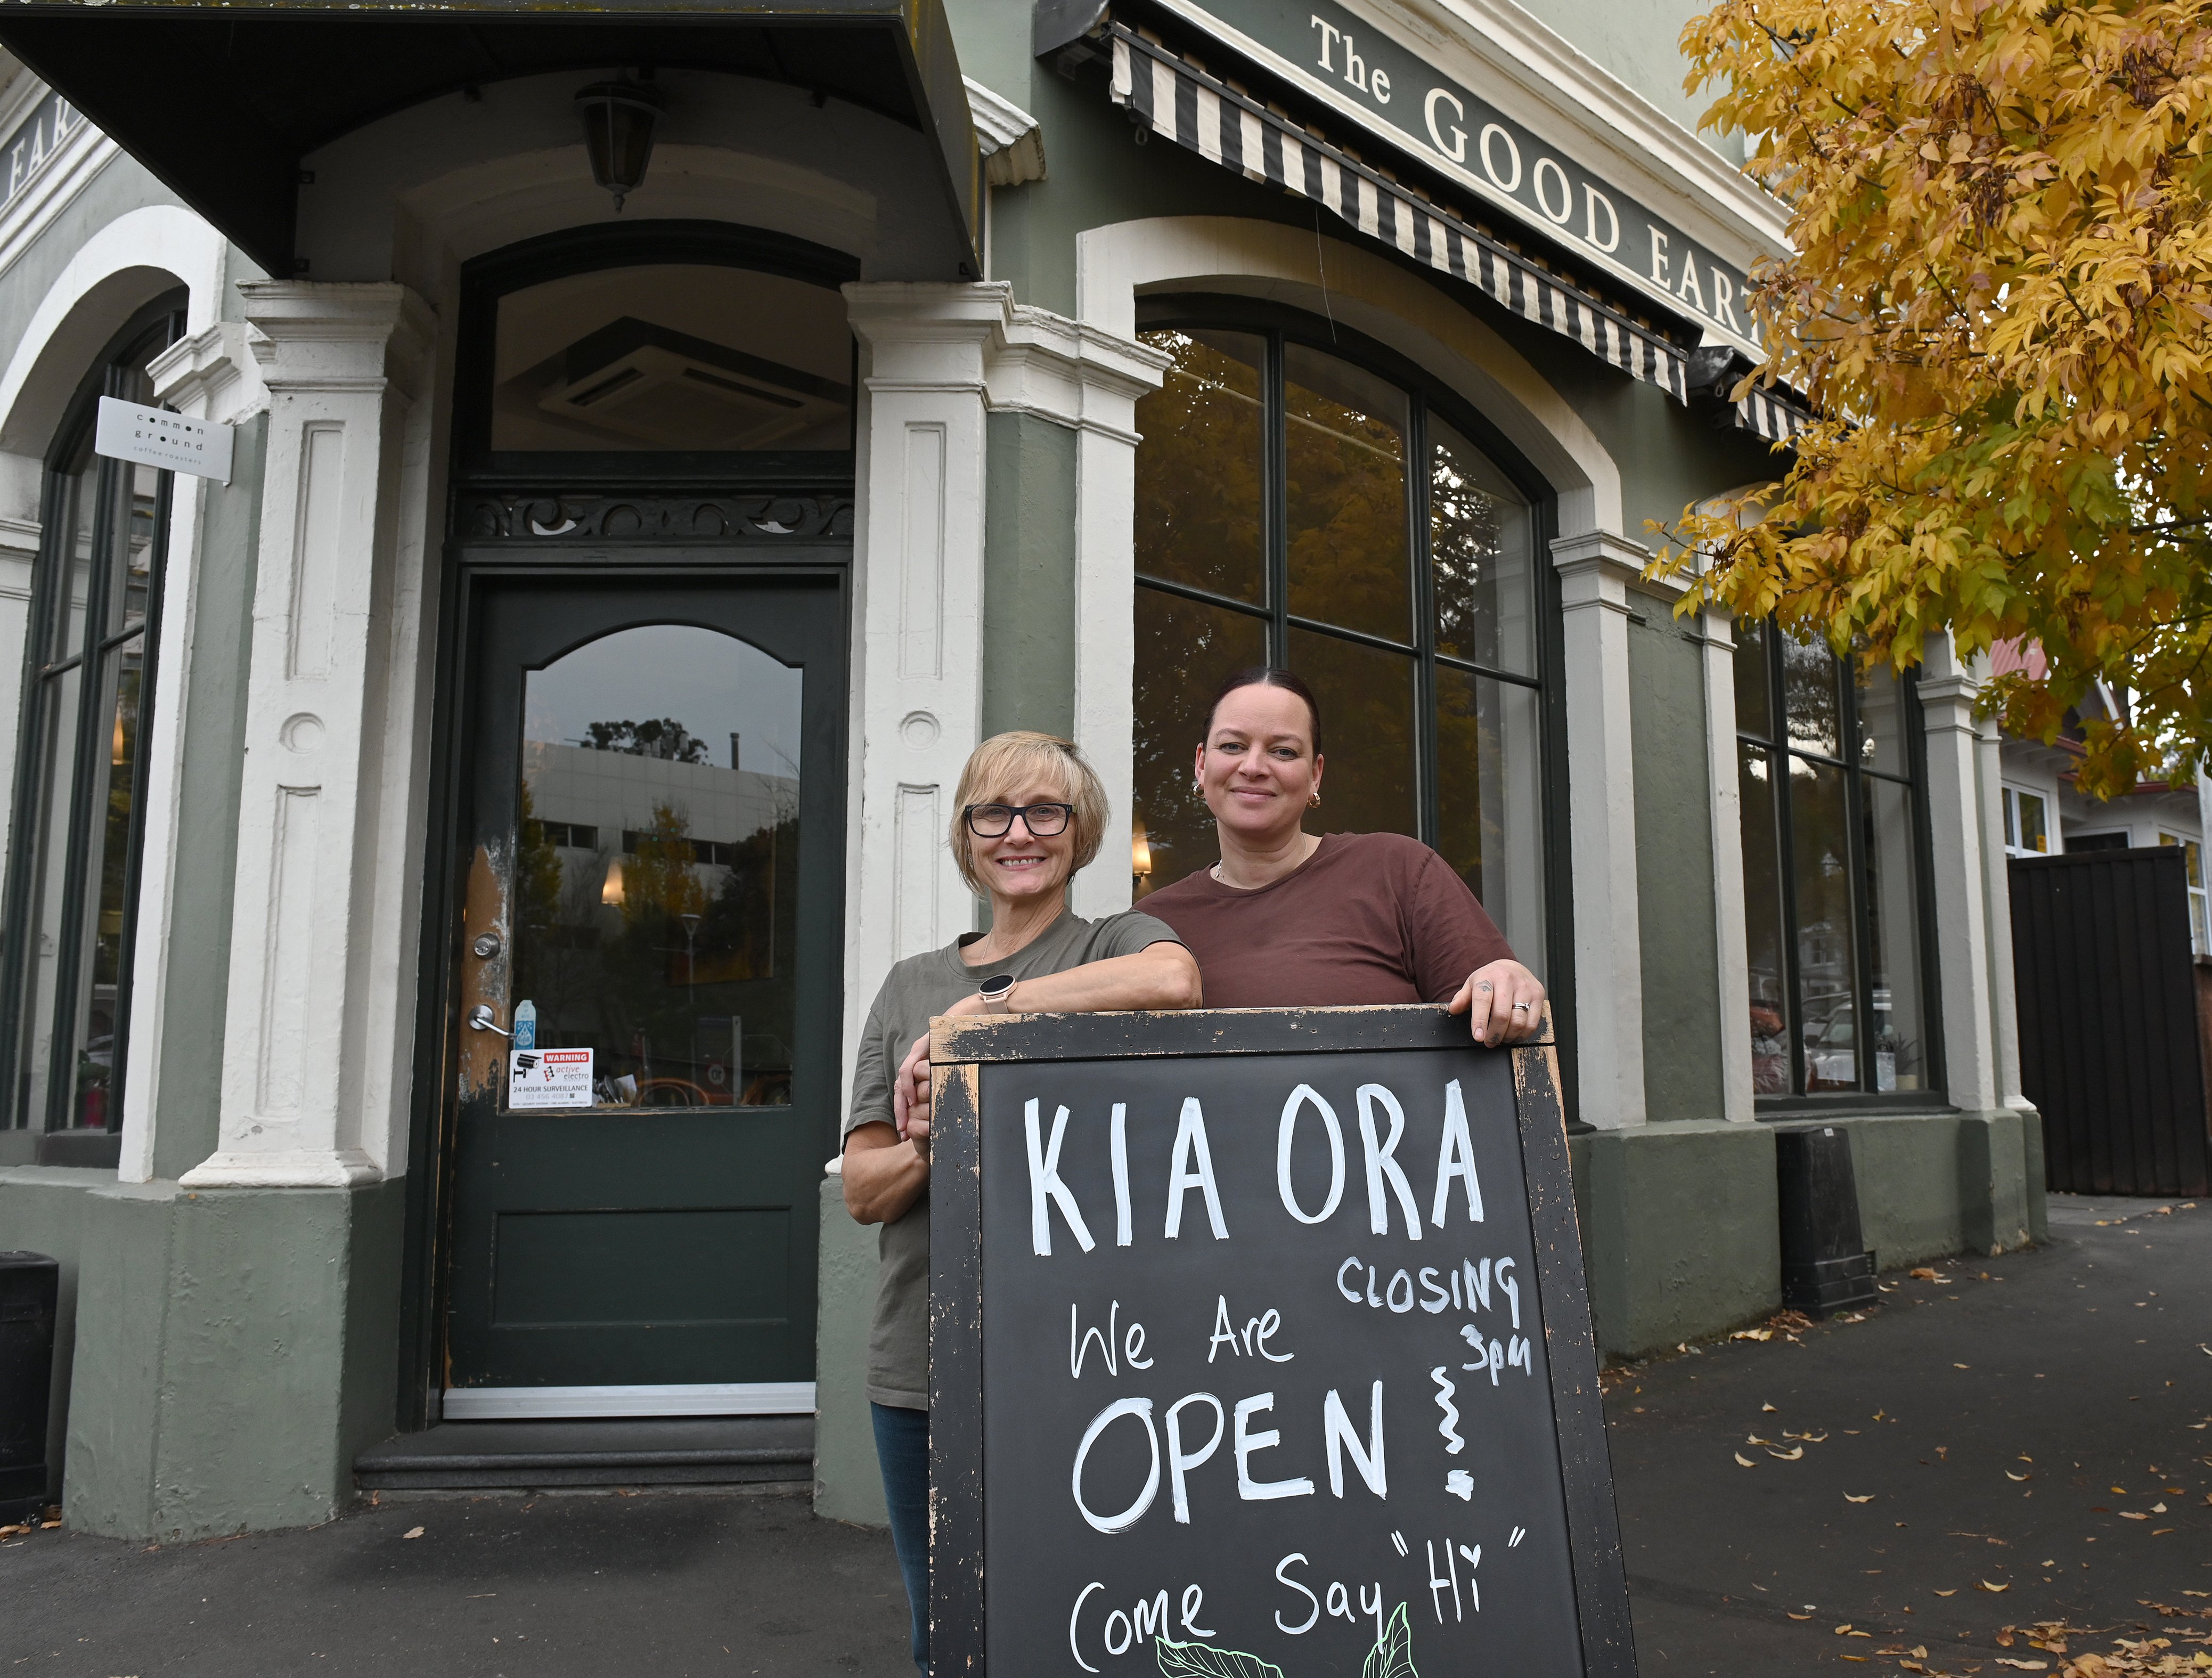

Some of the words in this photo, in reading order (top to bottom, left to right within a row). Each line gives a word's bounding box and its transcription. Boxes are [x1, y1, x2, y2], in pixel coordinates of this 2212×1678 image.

[1311, 14, 1391, 104] The
[1424, 87, 1620, 254] GOOD
[134, 429, 203, 451] ground
[136, 413, 204, 435] common
[133, 446, 162, 456] coffee
[165, 453, 202, 465] roasters
[546, 1053, 587, 1062] WARNING
[556, 1064, 580, 1073] active
[564, 1070, 589, 1079] electro
[1024, 1097, 1229, 1257] KIA
[1277, 1078, 1484, 1241] ORA
[1337, 1256, 1521, 1330] CLOSING
[1071, 1299, 1154, 1379] We
[1208, 1294, 1295, 1364] Are
[1072, 1379, 1388, 1534] OPEN
[1070, 1581, 1217, 1673] Come
[1275, 1552, 1384, 1655] Say
